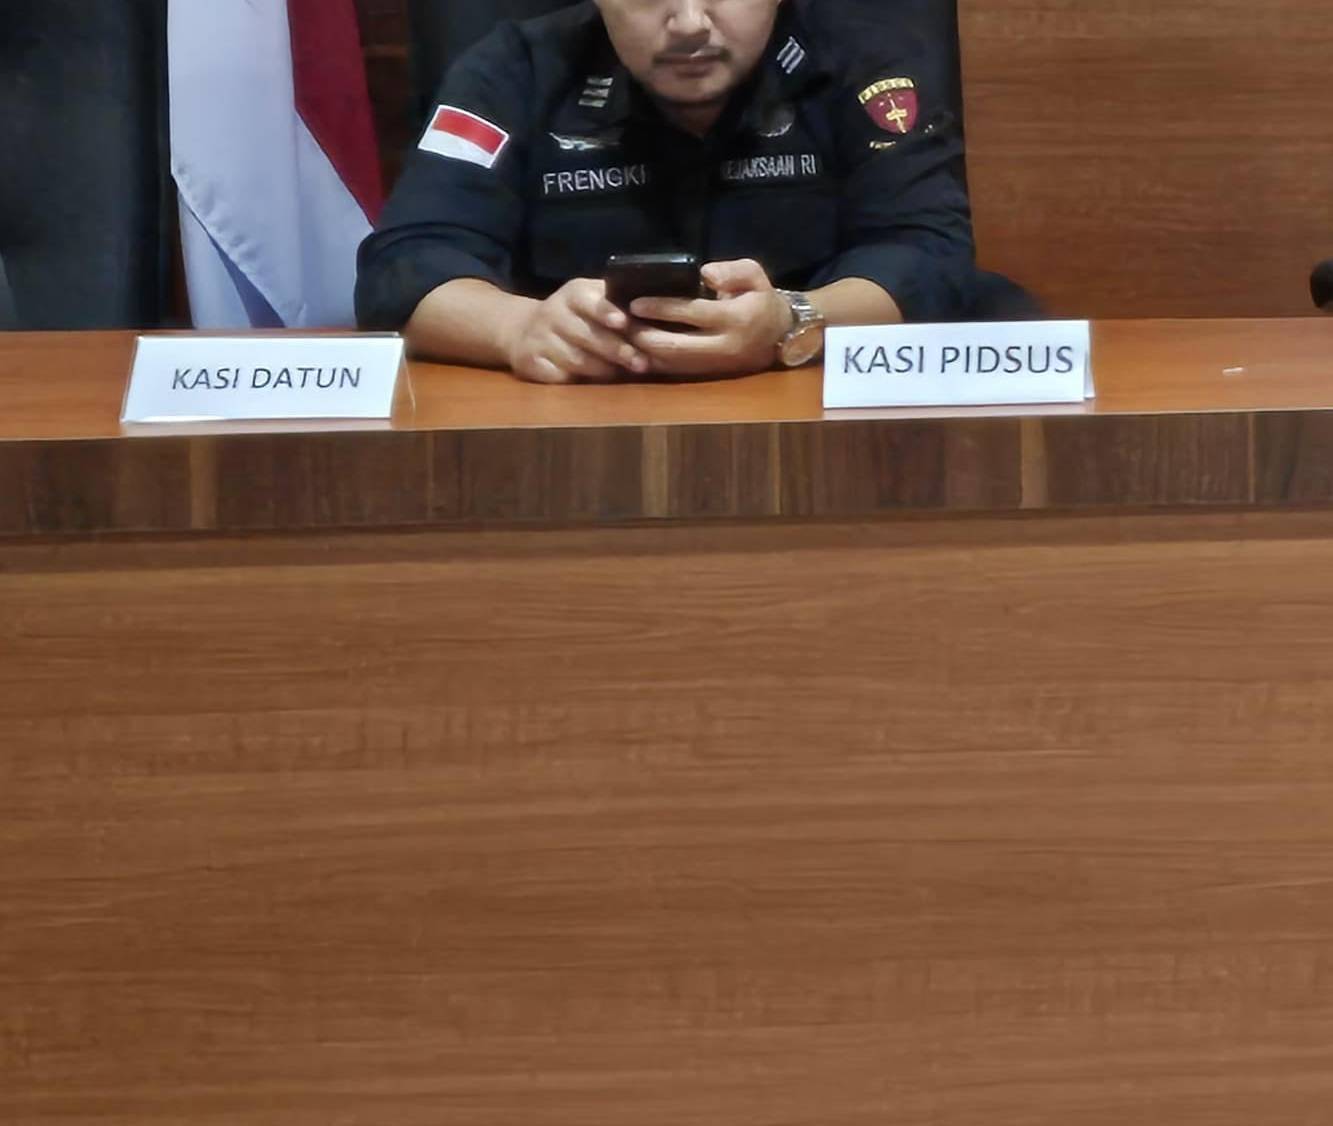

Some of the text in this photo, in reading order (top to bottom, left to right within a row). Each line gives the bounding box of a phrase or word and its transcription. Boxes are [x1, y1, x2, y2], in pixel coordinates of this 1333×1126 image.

[800, 153, 818, 175] RI
[542, 163, 647, 195] FRENGKI
[843, 345, 1074, 374] KASI PIDSUS
[171, 366, 362, 390] KASI DATUN
